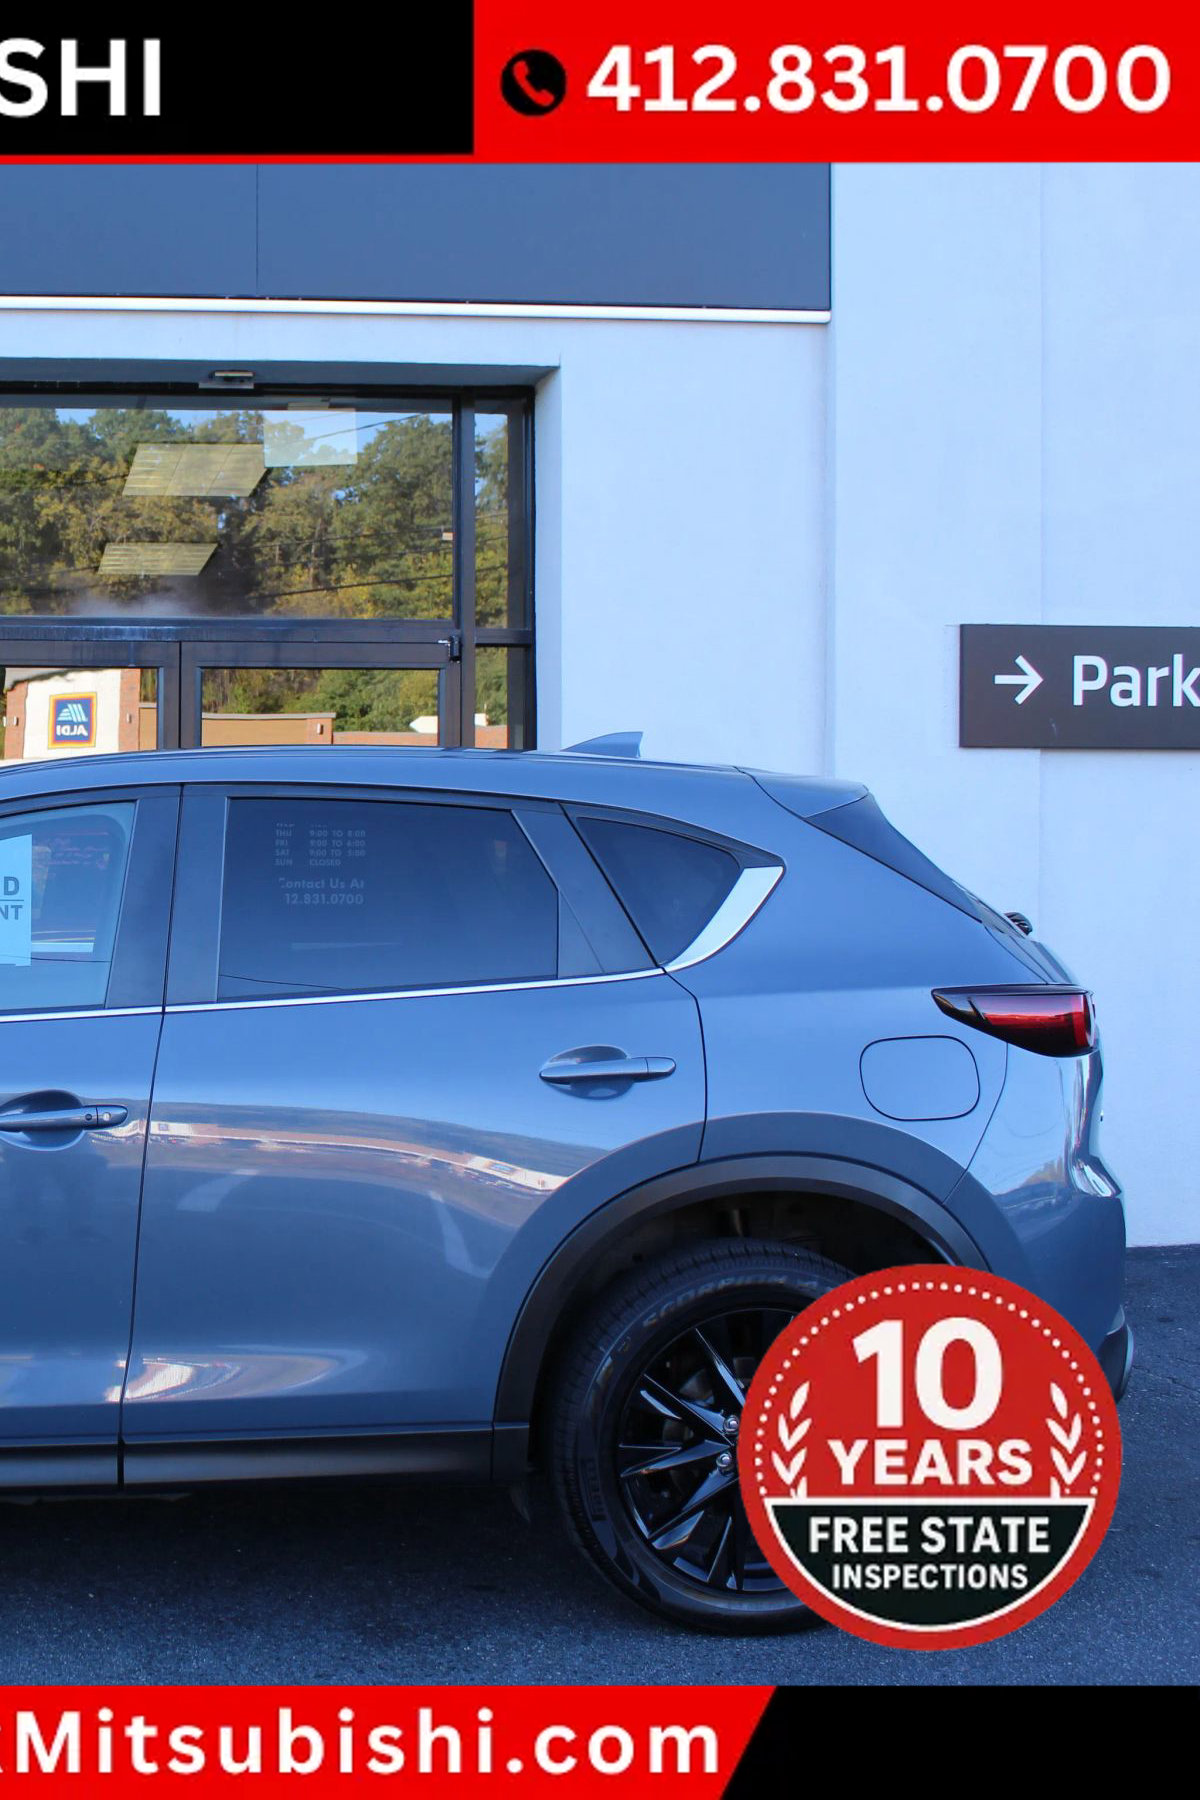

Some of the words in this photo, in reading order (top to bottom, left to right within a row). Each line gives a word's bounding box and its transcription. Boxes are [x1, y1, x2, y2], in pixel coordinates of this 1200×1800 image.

[1073, 653, 1200, 707] Park
[330, 878, 346, 889] Us
[350, 878, 365, 889] At
[284, 893, 365, 905] 12.831.0700
